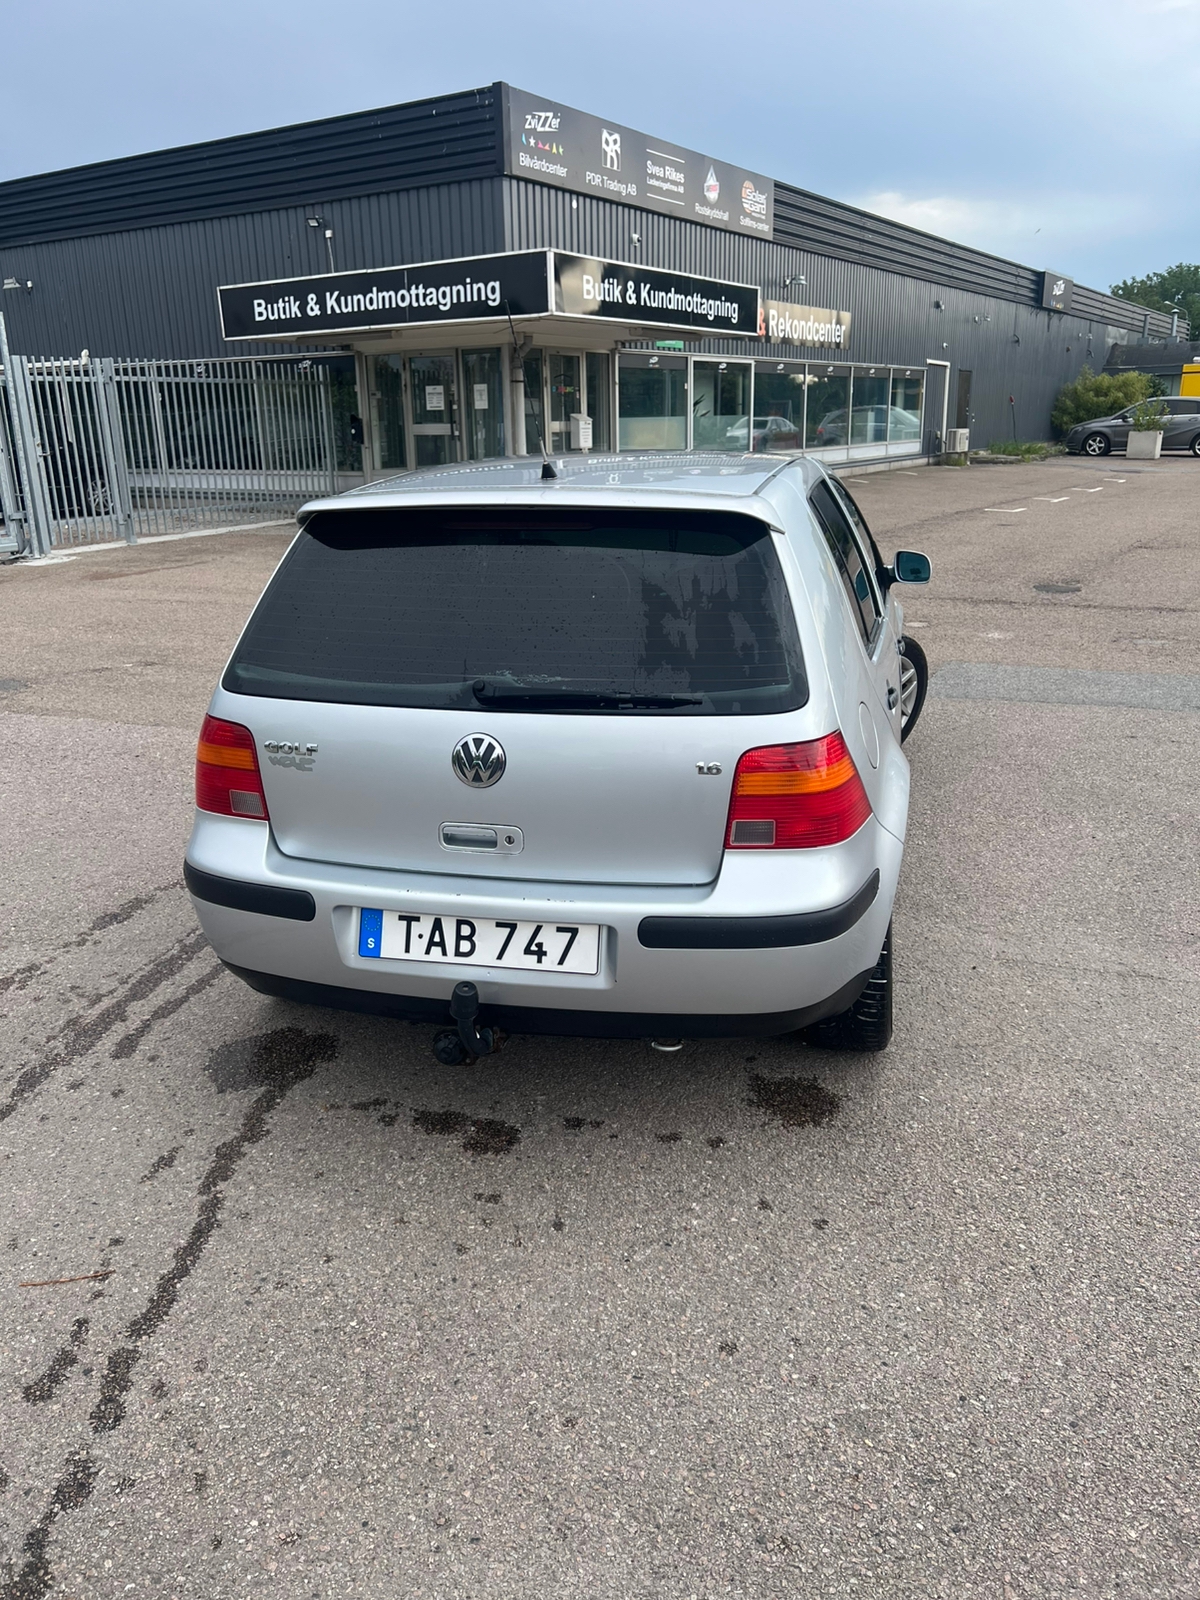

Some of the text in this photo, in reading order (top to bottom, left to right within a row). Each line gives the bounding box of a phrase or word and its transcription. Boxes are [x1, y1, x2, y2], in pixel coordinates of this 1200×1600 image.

[519, 152, 568, 177] Bilvårdcenter
[646, 160, 685, 183] Svea Rikes
[585, 171, 637, 196] PDR Trading AB
[252, 277, 501, 322] Butik & Kundmottagning
[582, 274, 739, 324] Butik & Kundmottagning
[768, 309, 846, 344] Rekondcenter
[264, 740, 318, 756] GOLF
[367, 937, 376, 949] S
[495, 921, 580, 966] 747
